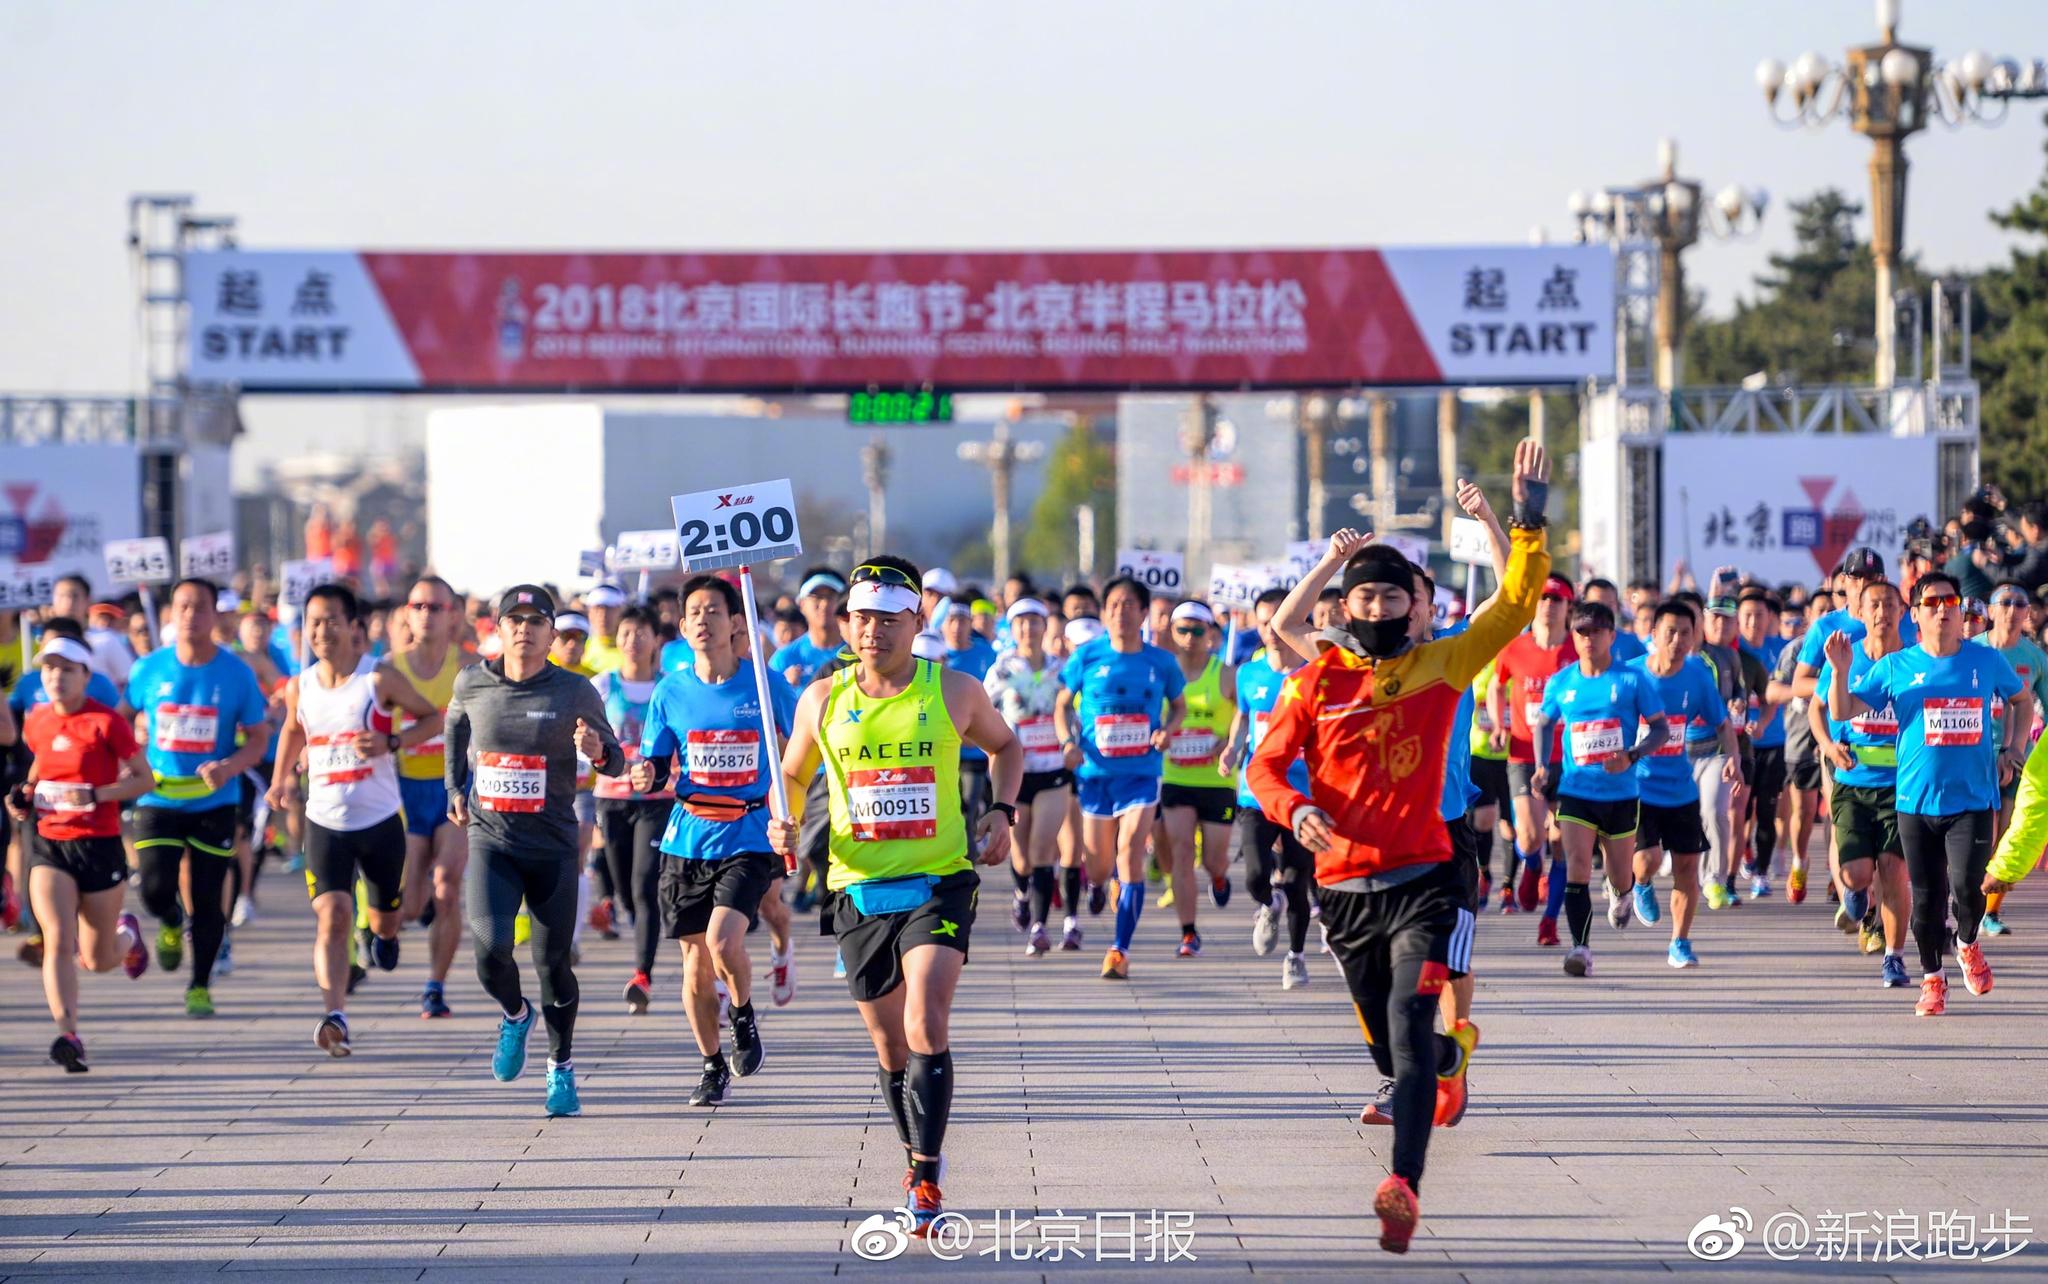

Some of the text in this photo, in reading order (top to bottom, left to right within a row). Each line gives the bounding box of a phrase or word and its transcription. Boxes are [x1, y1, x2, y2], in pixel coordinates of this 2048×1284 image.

[217, 270, 334, 316] 起点
[1465, 265, 1579, 311] 起点
[203, 325, 349, 362] START
[1450, 321, 1597, 356] START
[680, 506, 794, 557] 2:00
[1929, 717, 1980, 730] M11066
[694, 753, 754, 769] M05876
[838, 741, 934, 763] PACER
[854, 798, 930, 818] M00915
